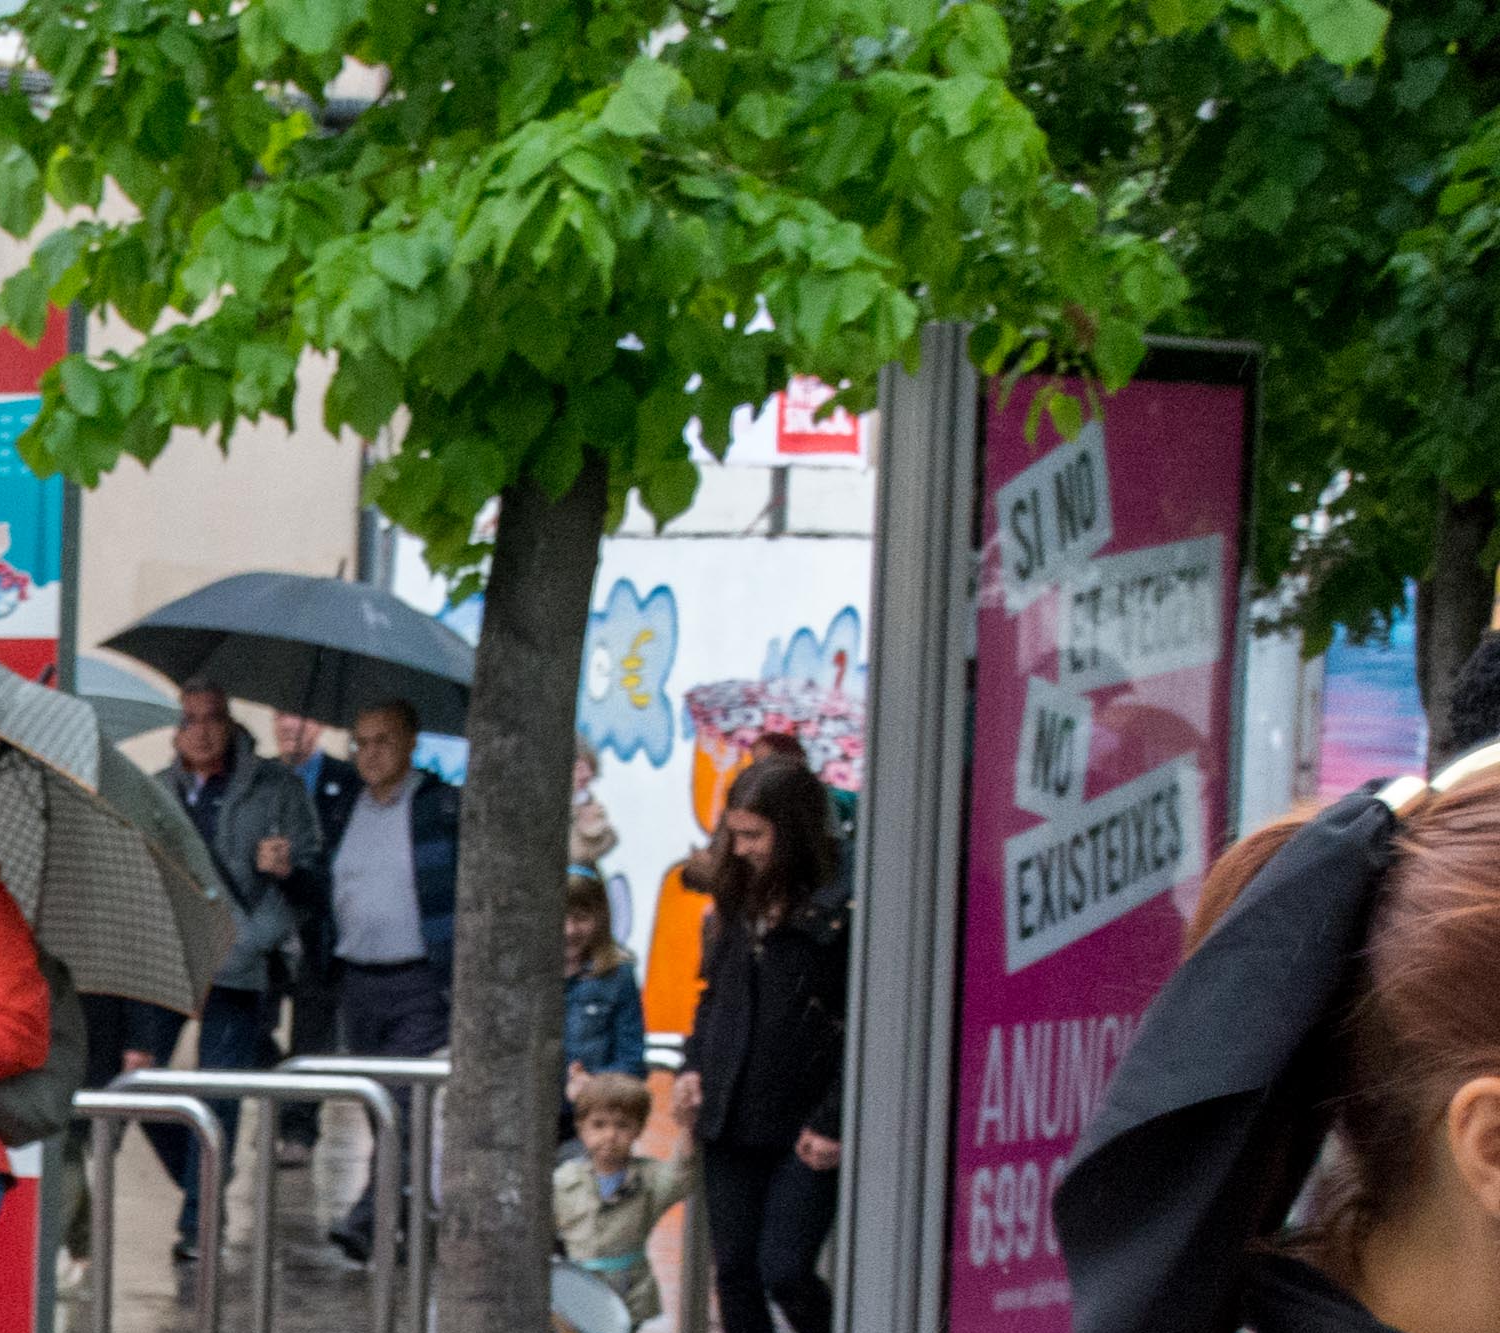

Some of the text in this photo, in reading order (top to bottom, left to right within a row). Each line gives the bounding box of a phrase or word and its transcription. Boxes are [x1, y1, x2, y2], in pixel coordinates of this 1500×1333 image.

[1010, 449, 1097, 582] SI NO
[1031, 706, 1077, 798] NO
[1016, 782, 1185, 941] EXISTEIXES
[969, 1161, 1040, 1268] 699
